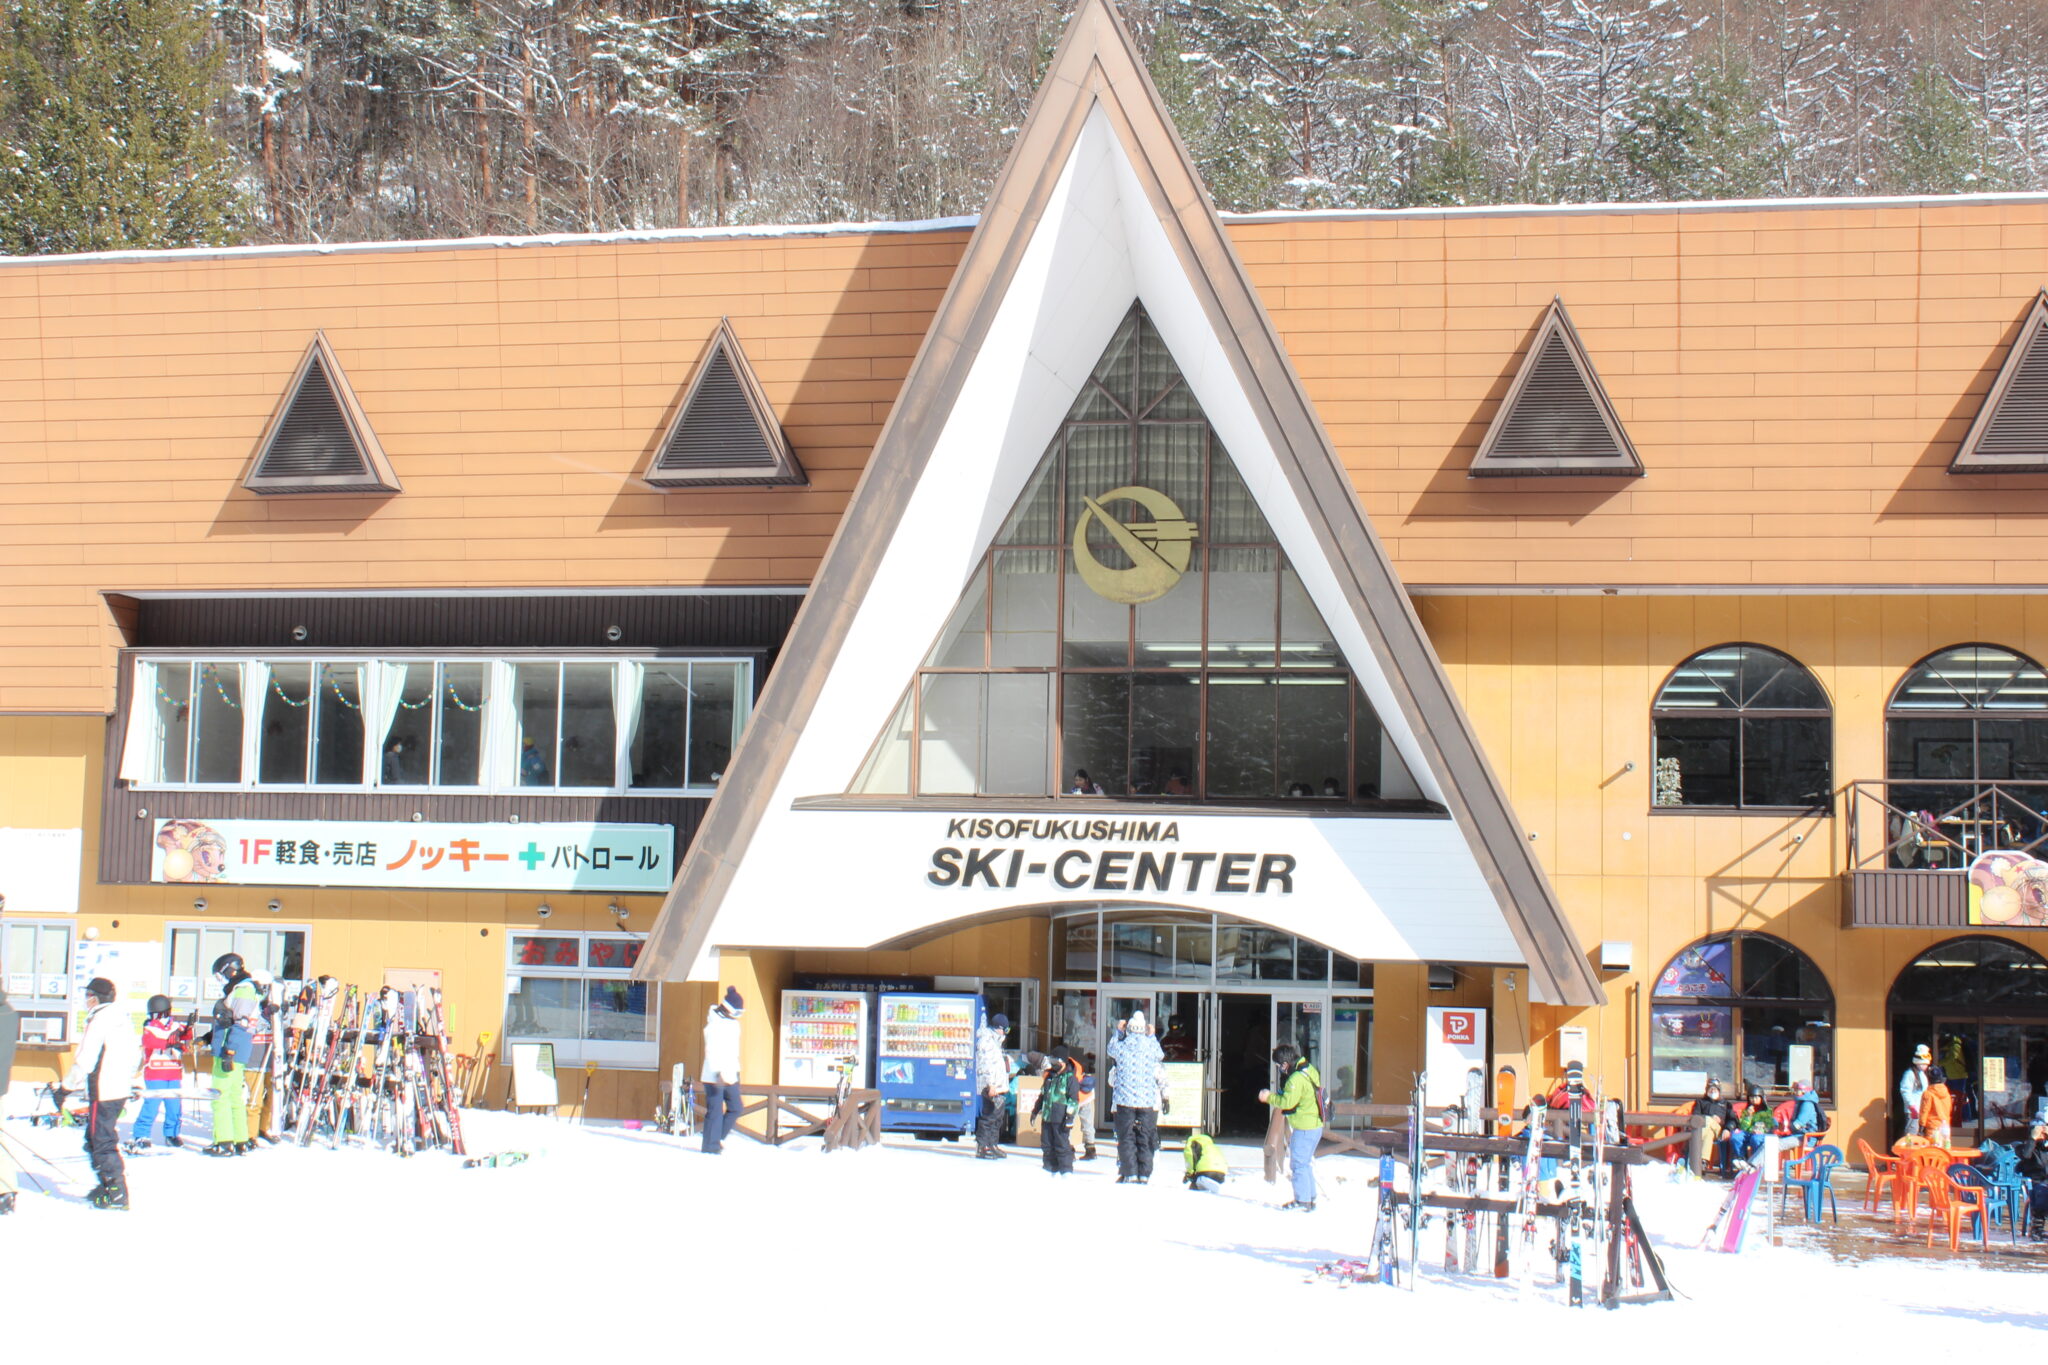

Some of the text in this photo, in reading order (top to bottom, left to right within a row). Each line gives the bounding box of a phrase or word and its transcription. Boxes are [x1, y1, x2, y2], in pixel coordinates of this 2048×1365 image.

[947, 818, 1180, 842] KISOFUKUSHIMA
[386, 836, 509, 872] ノッキー
[551, 844, 660, 871] パトロール
[927, 847, 1297, 893] SKI-CENTER
[48, 981, 59, 994] 3
[178, 983, 189, 996] 2
[1447, 1033, 1470, 1041] POKKA
